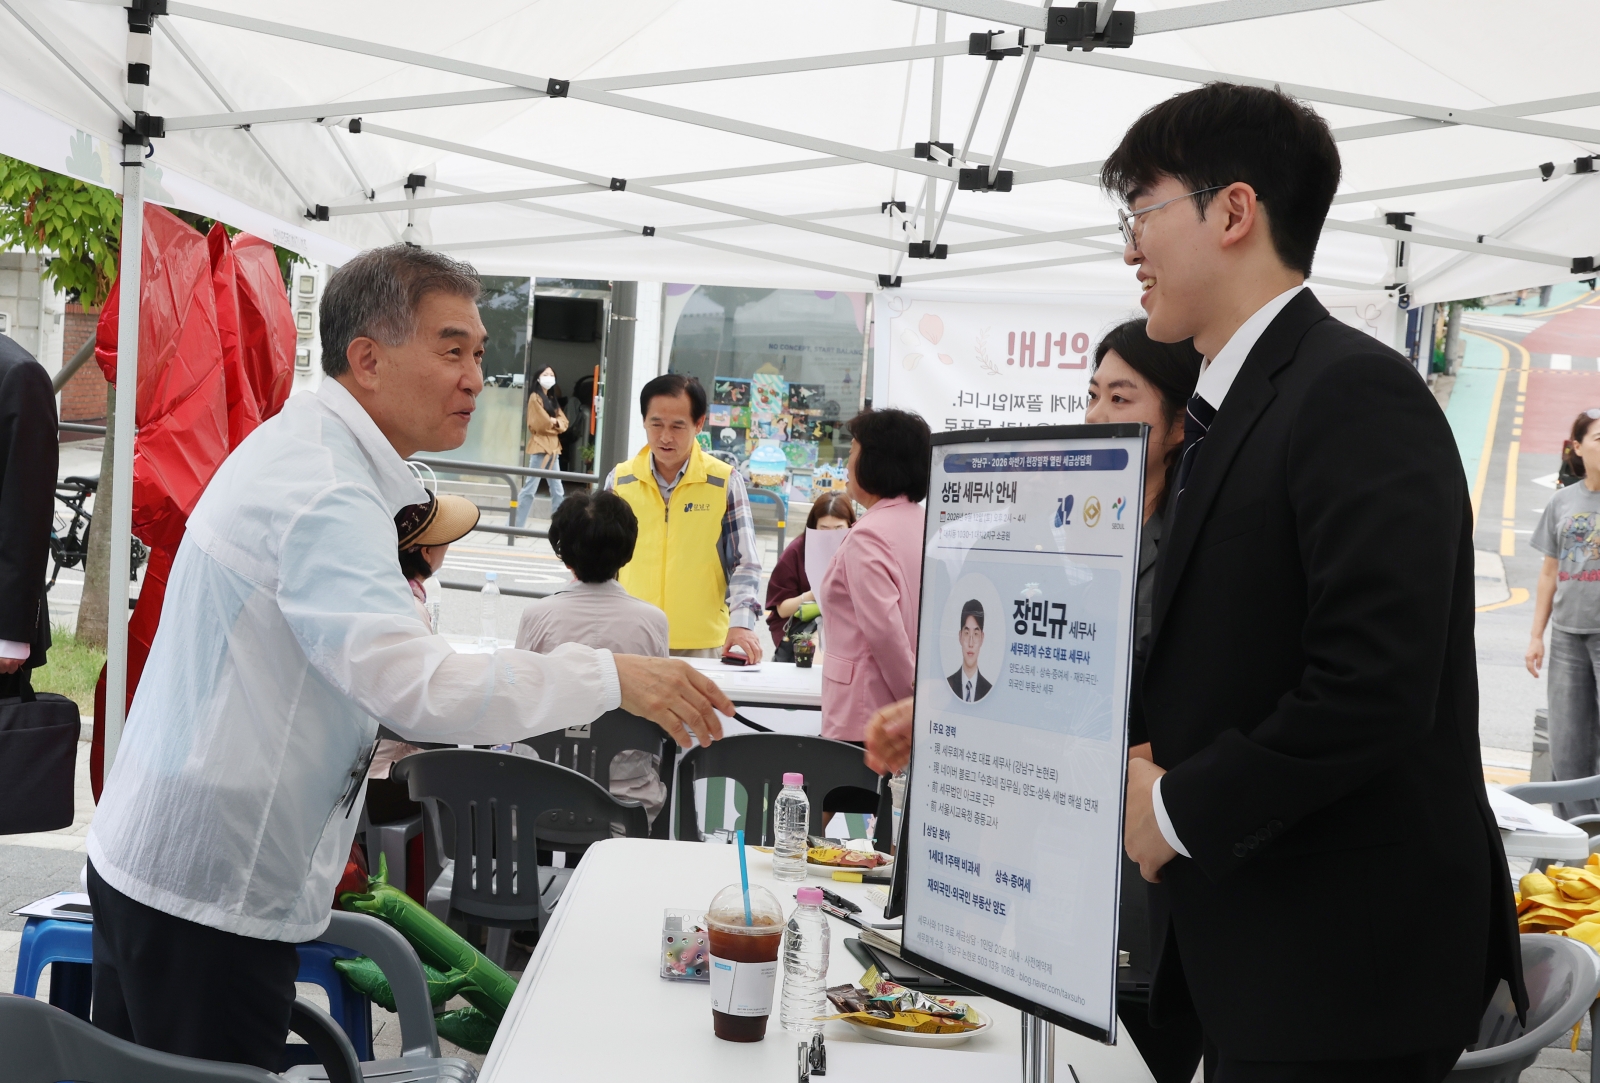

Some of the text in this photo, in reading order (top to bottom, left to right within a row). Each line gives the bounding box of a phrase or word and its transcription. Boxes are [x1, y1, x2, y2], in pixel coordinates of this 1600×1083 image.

[972, 454, 1093, 468] 강남구 2026 하반기 현장밀착 열린 세금상담회
[942, 481, 1018, 504] 상담 세무사 안내
[1012, 598, 1096, 641] 장민규 세무사
[1010, 642, 1090, 665] 세무회계 수호 대표 세무사
[1009, 663, 1036, 677] 양도소득세
[1008, 678, 1054, 695] 외국인 부동산 세무
[933, 722, 956, 738] 주요 경력
[941, 745, 965, 761] 세무회계
[965, 751, 977, 763] 수호
[978, 753, 991, 766] 대표
[992, 756, 1011, 772] 세무사
[1012, 760, 1034, 776] (강남구
[1035, 765, 1059, 783] 논현로)
[939, 782, 963, 800] 세무법인
[963, 788, 981, 805] 아크로
[982, 793, 995, 808] 근무
[940, 764, 958, 779] 네이버
[958, 768, 976, 783] 블로그
[1052, 791, 1067, 806] 세법
[1068, 794, 1082, 810] 해설
[1083, 797, 1099, 813] 연재
[938, 802, 973, 822] 서울시교육청
[974, 811, 999, 829] 중등교사
[926, 825, 951, 842] 상담 분야
[928, 849, 981, 877] 1세대 1주택 비과세
[995, 869, 1031, 893] 상속·증여세
[927, 878, 1006, 916] 재외국민·외국인 부동산 양도
[917, 914, 937, 931] 세무사와
[944, 925, 955, 937] 무료
[955, 929, 977, 946] 세금상담
[980, 938, 994, 953] 1인당
[1008, 948, 1021, 962] 이내
[916, 931, 935, 947] 세무회계
[935, 938, 944, 950] 수호
[947, 943, 961, 957] 강남구
[977, 955, 988, 967] 503
[1018, 972, 1086, 1006] blog.naver.com/taxsuho
